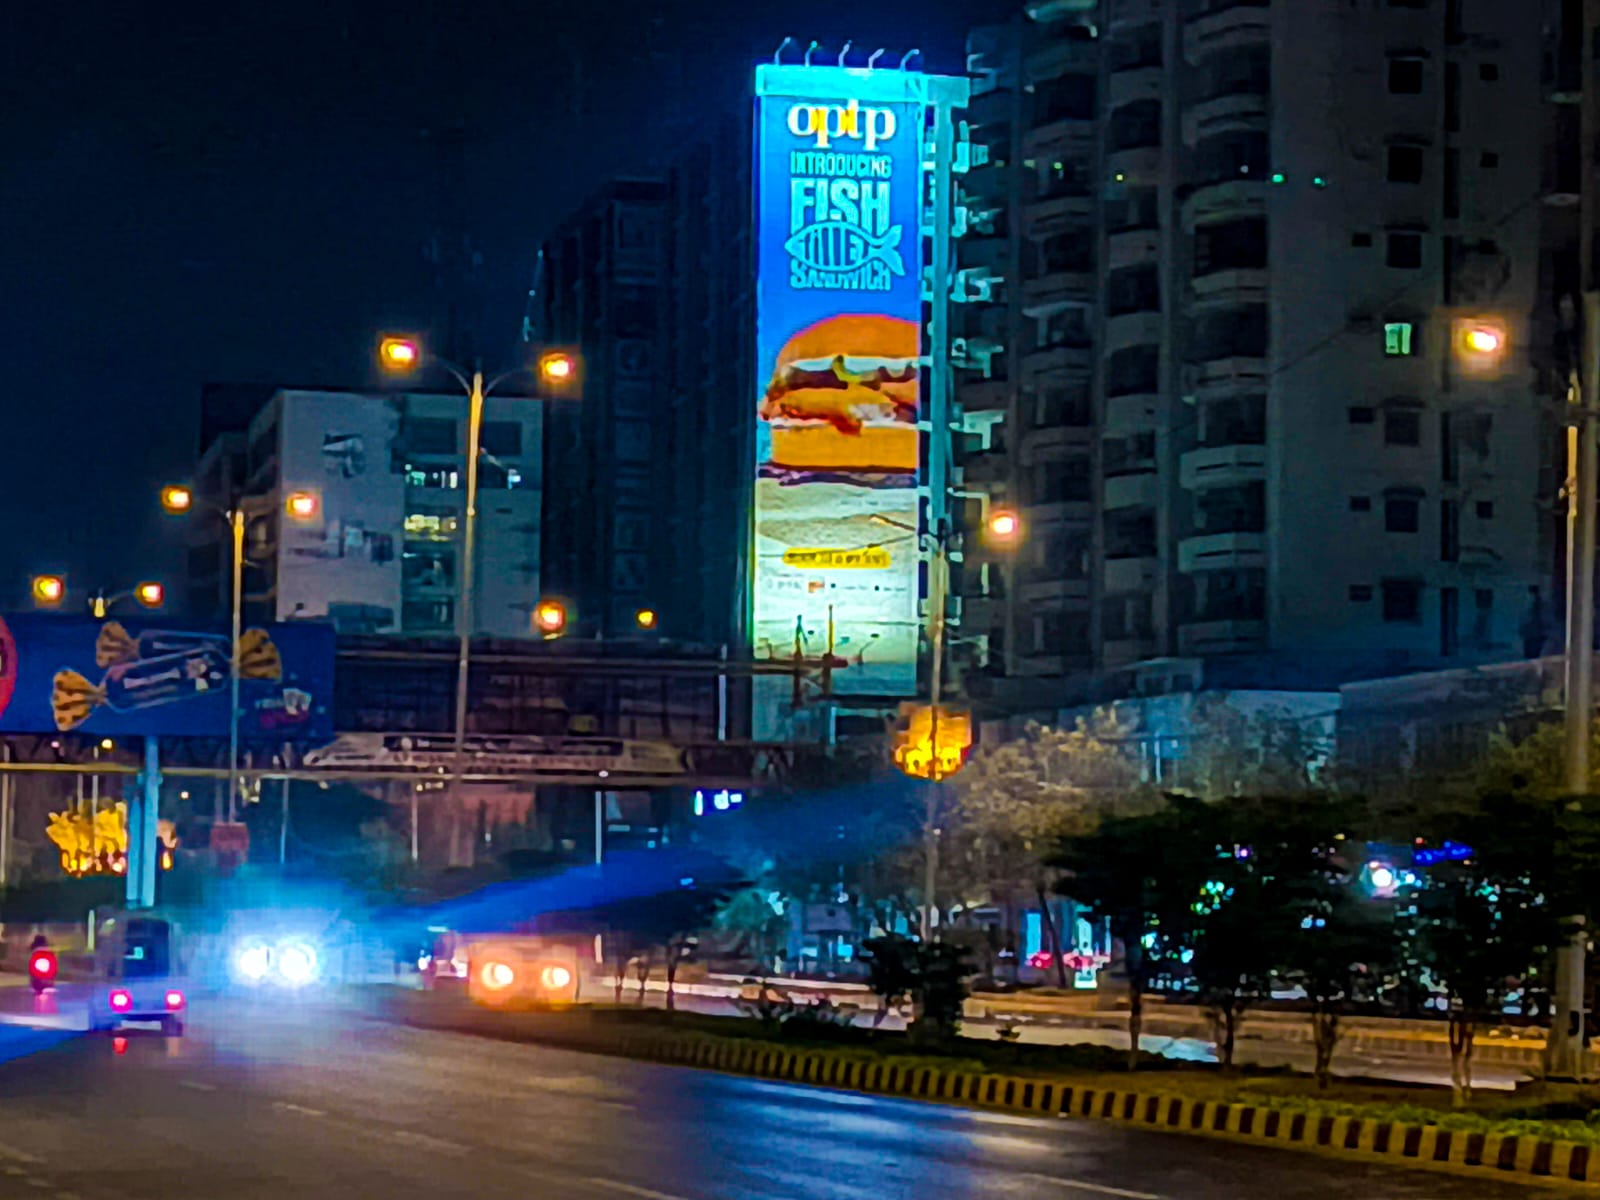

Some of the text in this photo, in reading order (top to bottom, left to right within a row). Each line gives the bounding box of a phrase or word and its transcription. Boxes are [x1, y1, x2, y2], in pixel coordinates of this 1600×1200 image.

[787, 99, 896, 150] optp
[790, 152, 892, 178] INTRODUCING
[790, 179, 892, 237] FISH
[790, 258, 891, 290] SANDWICH
